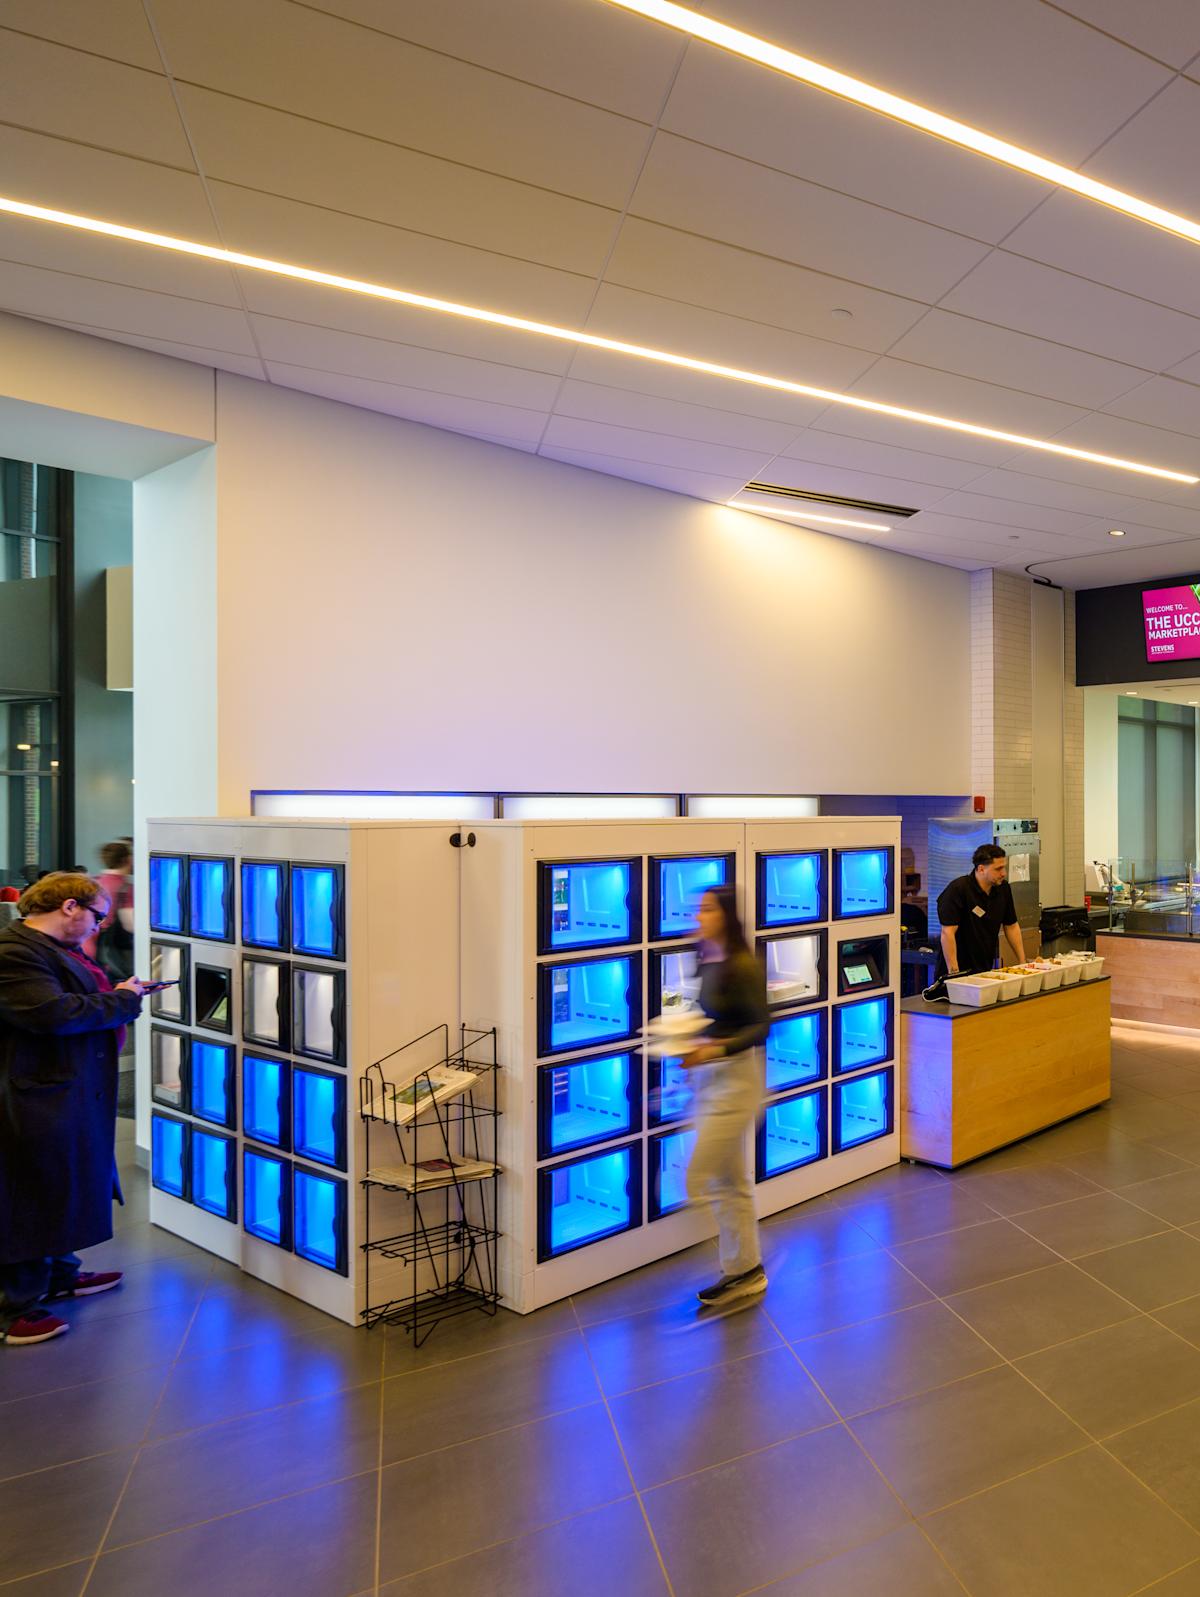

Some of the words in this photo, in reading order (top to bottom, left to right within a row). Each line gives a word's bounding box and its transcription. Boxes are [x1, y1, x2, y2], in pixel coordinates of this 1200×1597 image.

[1146, 605, 1174, 614] WELCOME
[1146, 615, 1172, 630] THE
[1174, 612, 1200, 627] UCC
[1151, 644, 1175, 653] STEVENS
